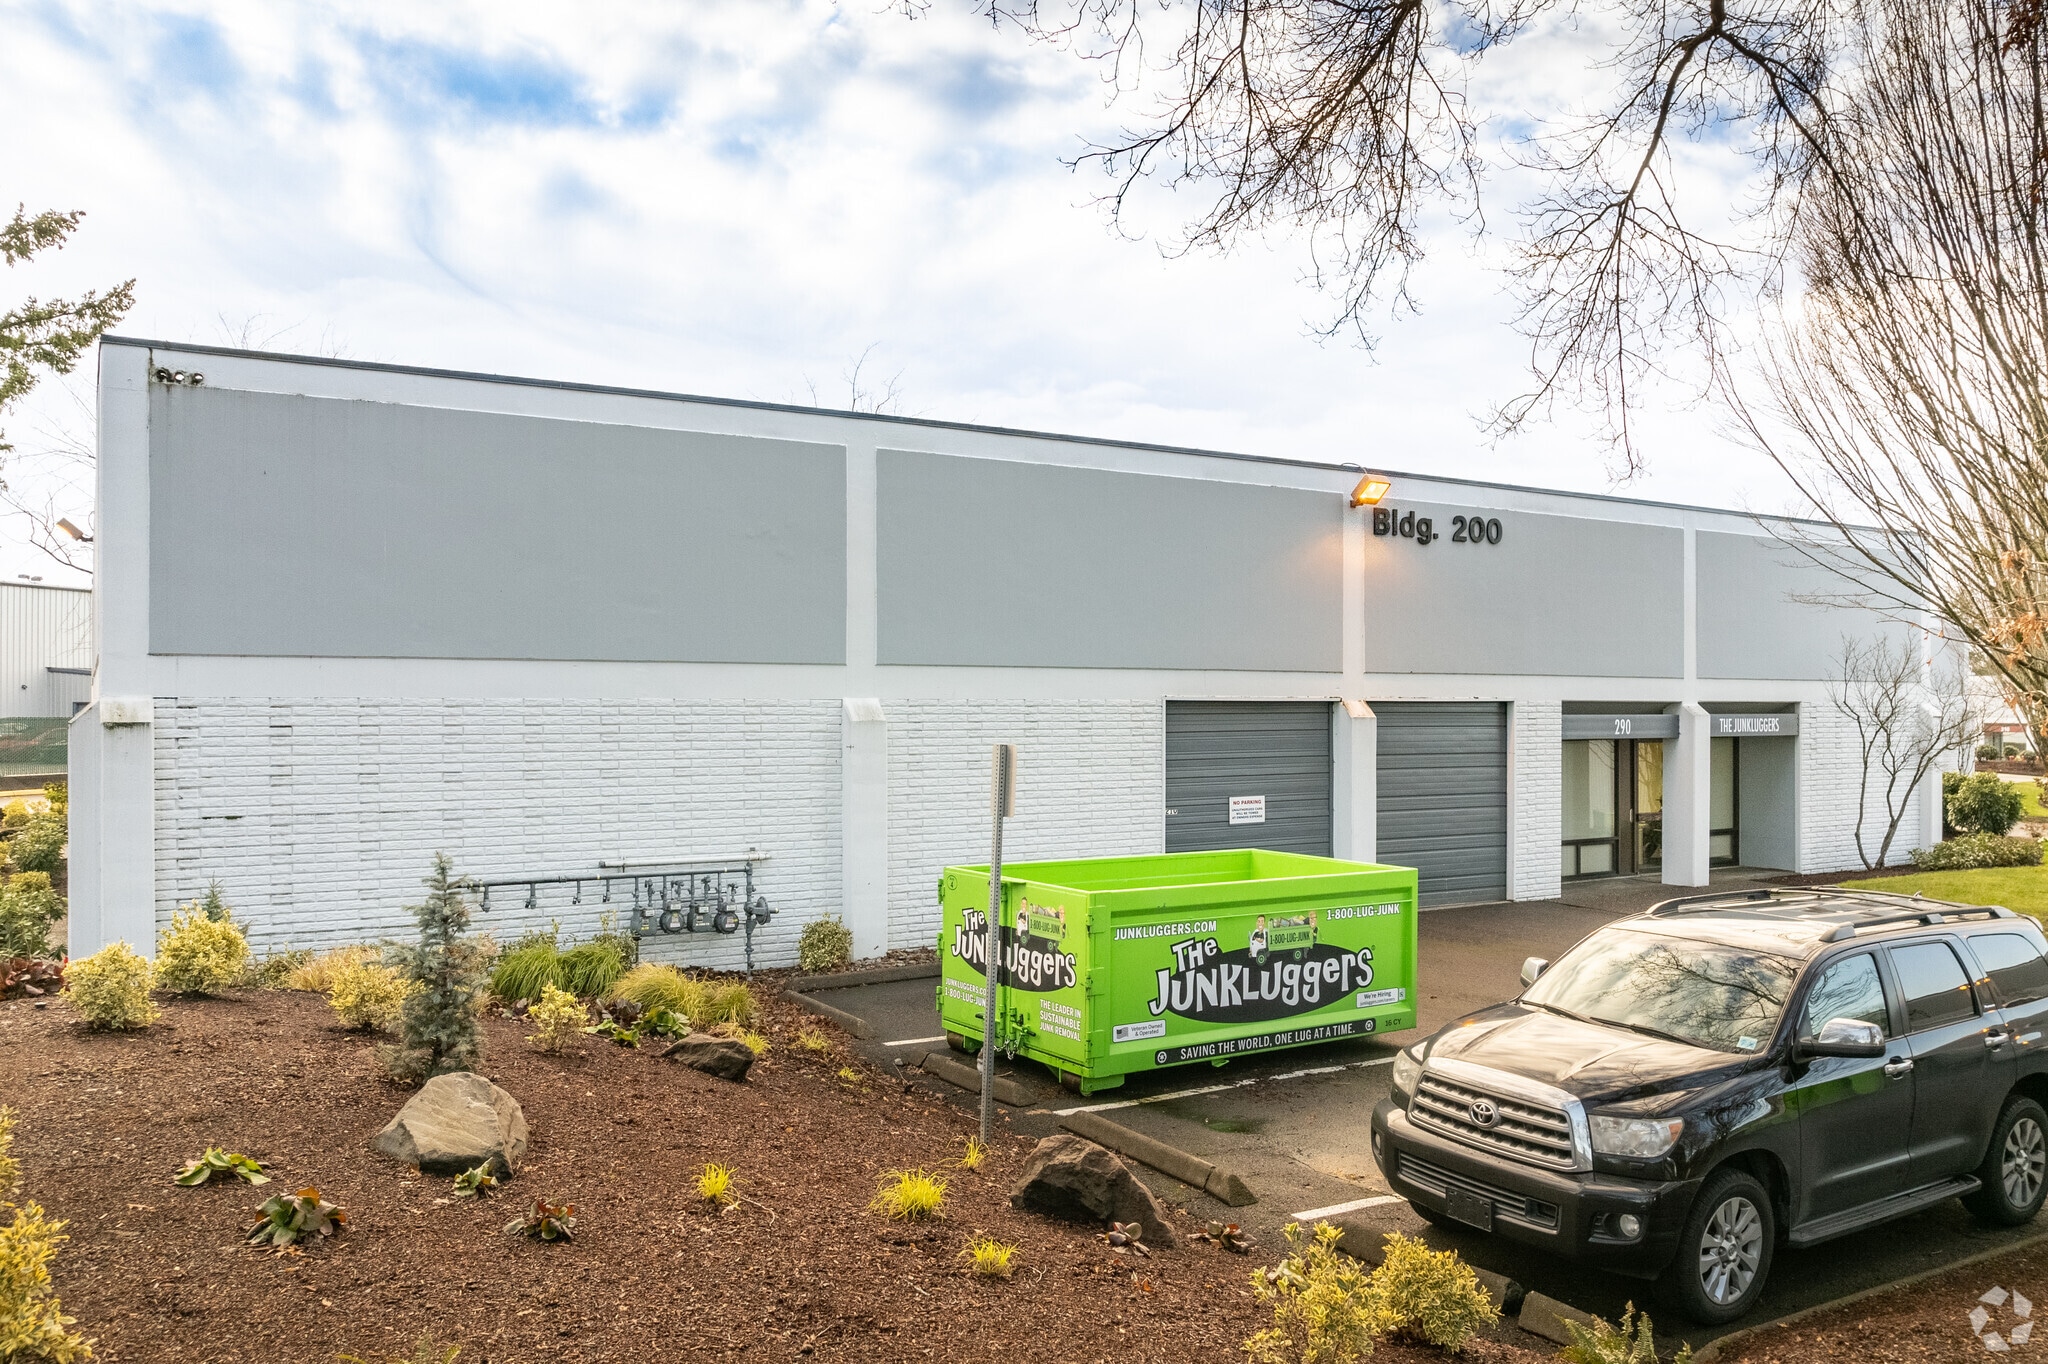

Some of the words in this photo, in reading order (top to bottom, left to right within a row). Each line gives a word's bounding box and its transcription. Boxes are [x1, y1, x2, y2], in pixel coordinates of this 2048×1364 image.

[1373, 507, 1439, 545] Bldg.
[1452, 515, 1503, 545] 200
[1614, 719, 1631, 735] 290
[1720, 718, 1732, 733] THE
[1733, 717, 1780, 732] JUNKLUGGERS
[1326, 903, 1400, 920] 1-800-LUG-JUNK
[1030, 919, 1060, 934] 1-800-LUG-JUNK
[1114, 920, 1217, 941] JUNKLUGGERS.COM
[1270, 931, 1310, 945] 1-800-LUG-JUNK
[946, 977, 987, 996] JUNKLUGGERS.CO
[945, 987, 987, 1007] 1-800-LUG-JUN
[1040, 999, 1051, 1010] THE
[1052, 1002, 1074, 1016] LEADER
[1075, 1009, 1082, 1019] IN
[1040, 1010, 1081, 1031] SUSTAINABLE
[1040, 1022, 1054, 1033] JUNK
[1054, 1026, 1081, 1042] REMOVAL
[1139, 1029, 1159, 1037] Operated
[1180, 1044, 1216, 1059] SAVING
[1218, 1041, 1236, 1053] THE
[1238, 1036, 1273, 1050] WORLD,
[1274, 1032, 1292, 1045] ONE
[1295, 1029, 1312, 1042] LUG
[1313, 1027, 1323, 1039] AT
[1325, 1027, 1331, 1037] A
[1332, 1023, 1355, 1036] TIME.
